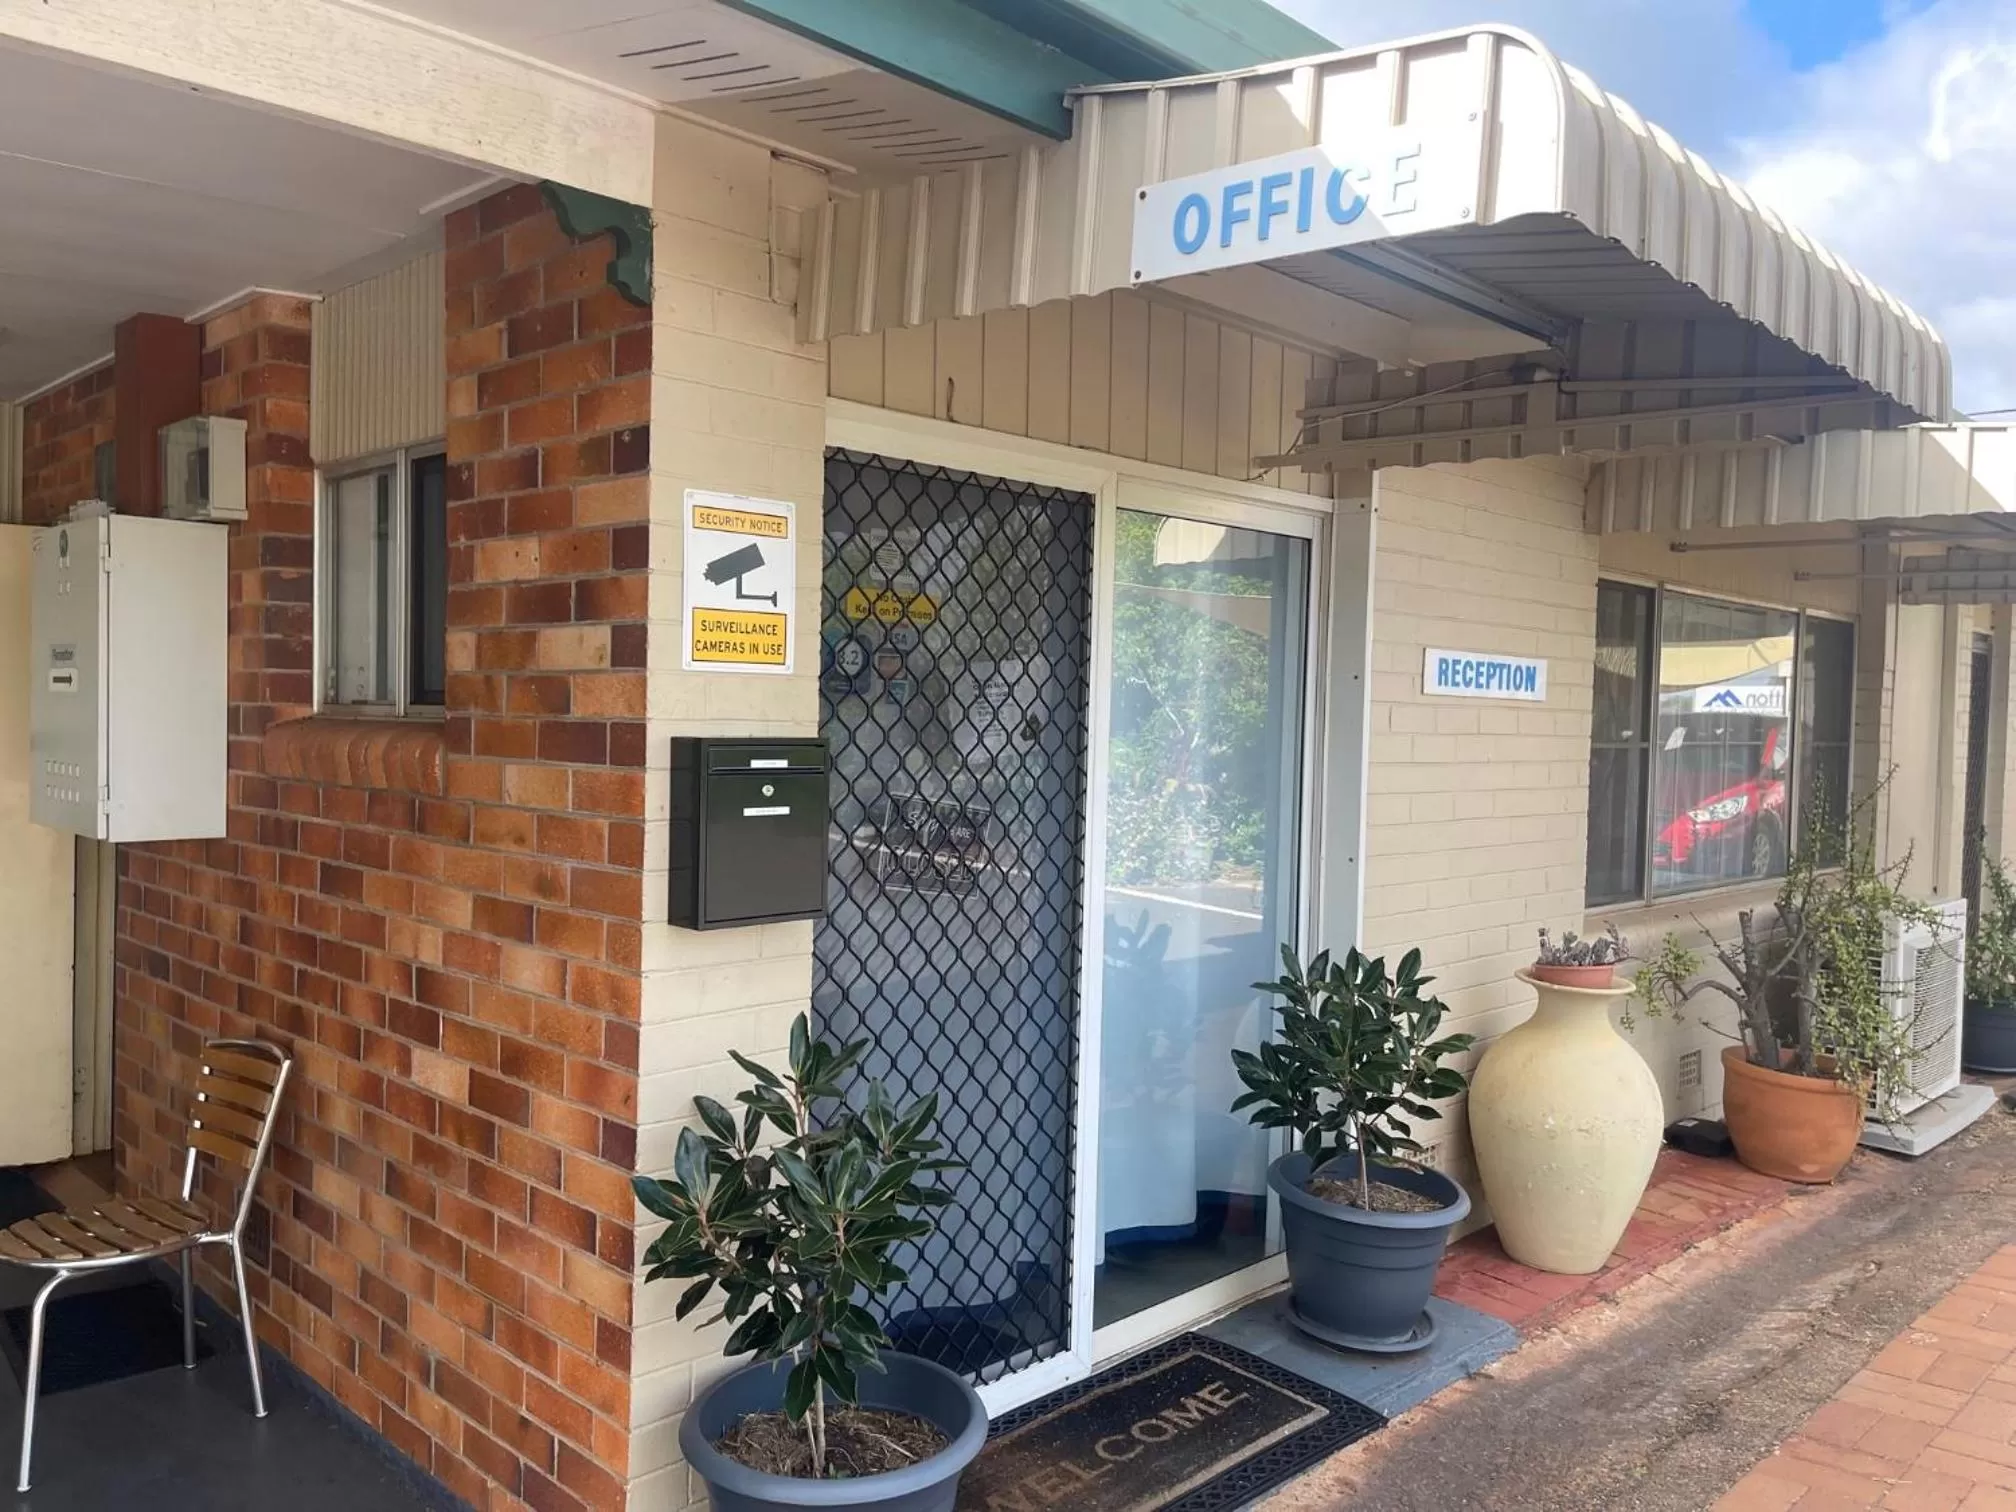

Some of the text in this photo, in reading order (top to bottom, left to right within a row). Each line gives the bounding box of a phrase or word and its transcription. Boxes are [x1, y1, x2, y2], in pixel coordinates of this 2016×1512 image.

[1173, 143, 1421, 255] OFFICE
[700, 513, 782, 533] SECURITY NOTICE
[701, 620, 778, 636] SURVEILLANCE
[694, 639, 783, 656] CAMERAS IN USE
[1437, 657, 1537, 692] RECEPTION
